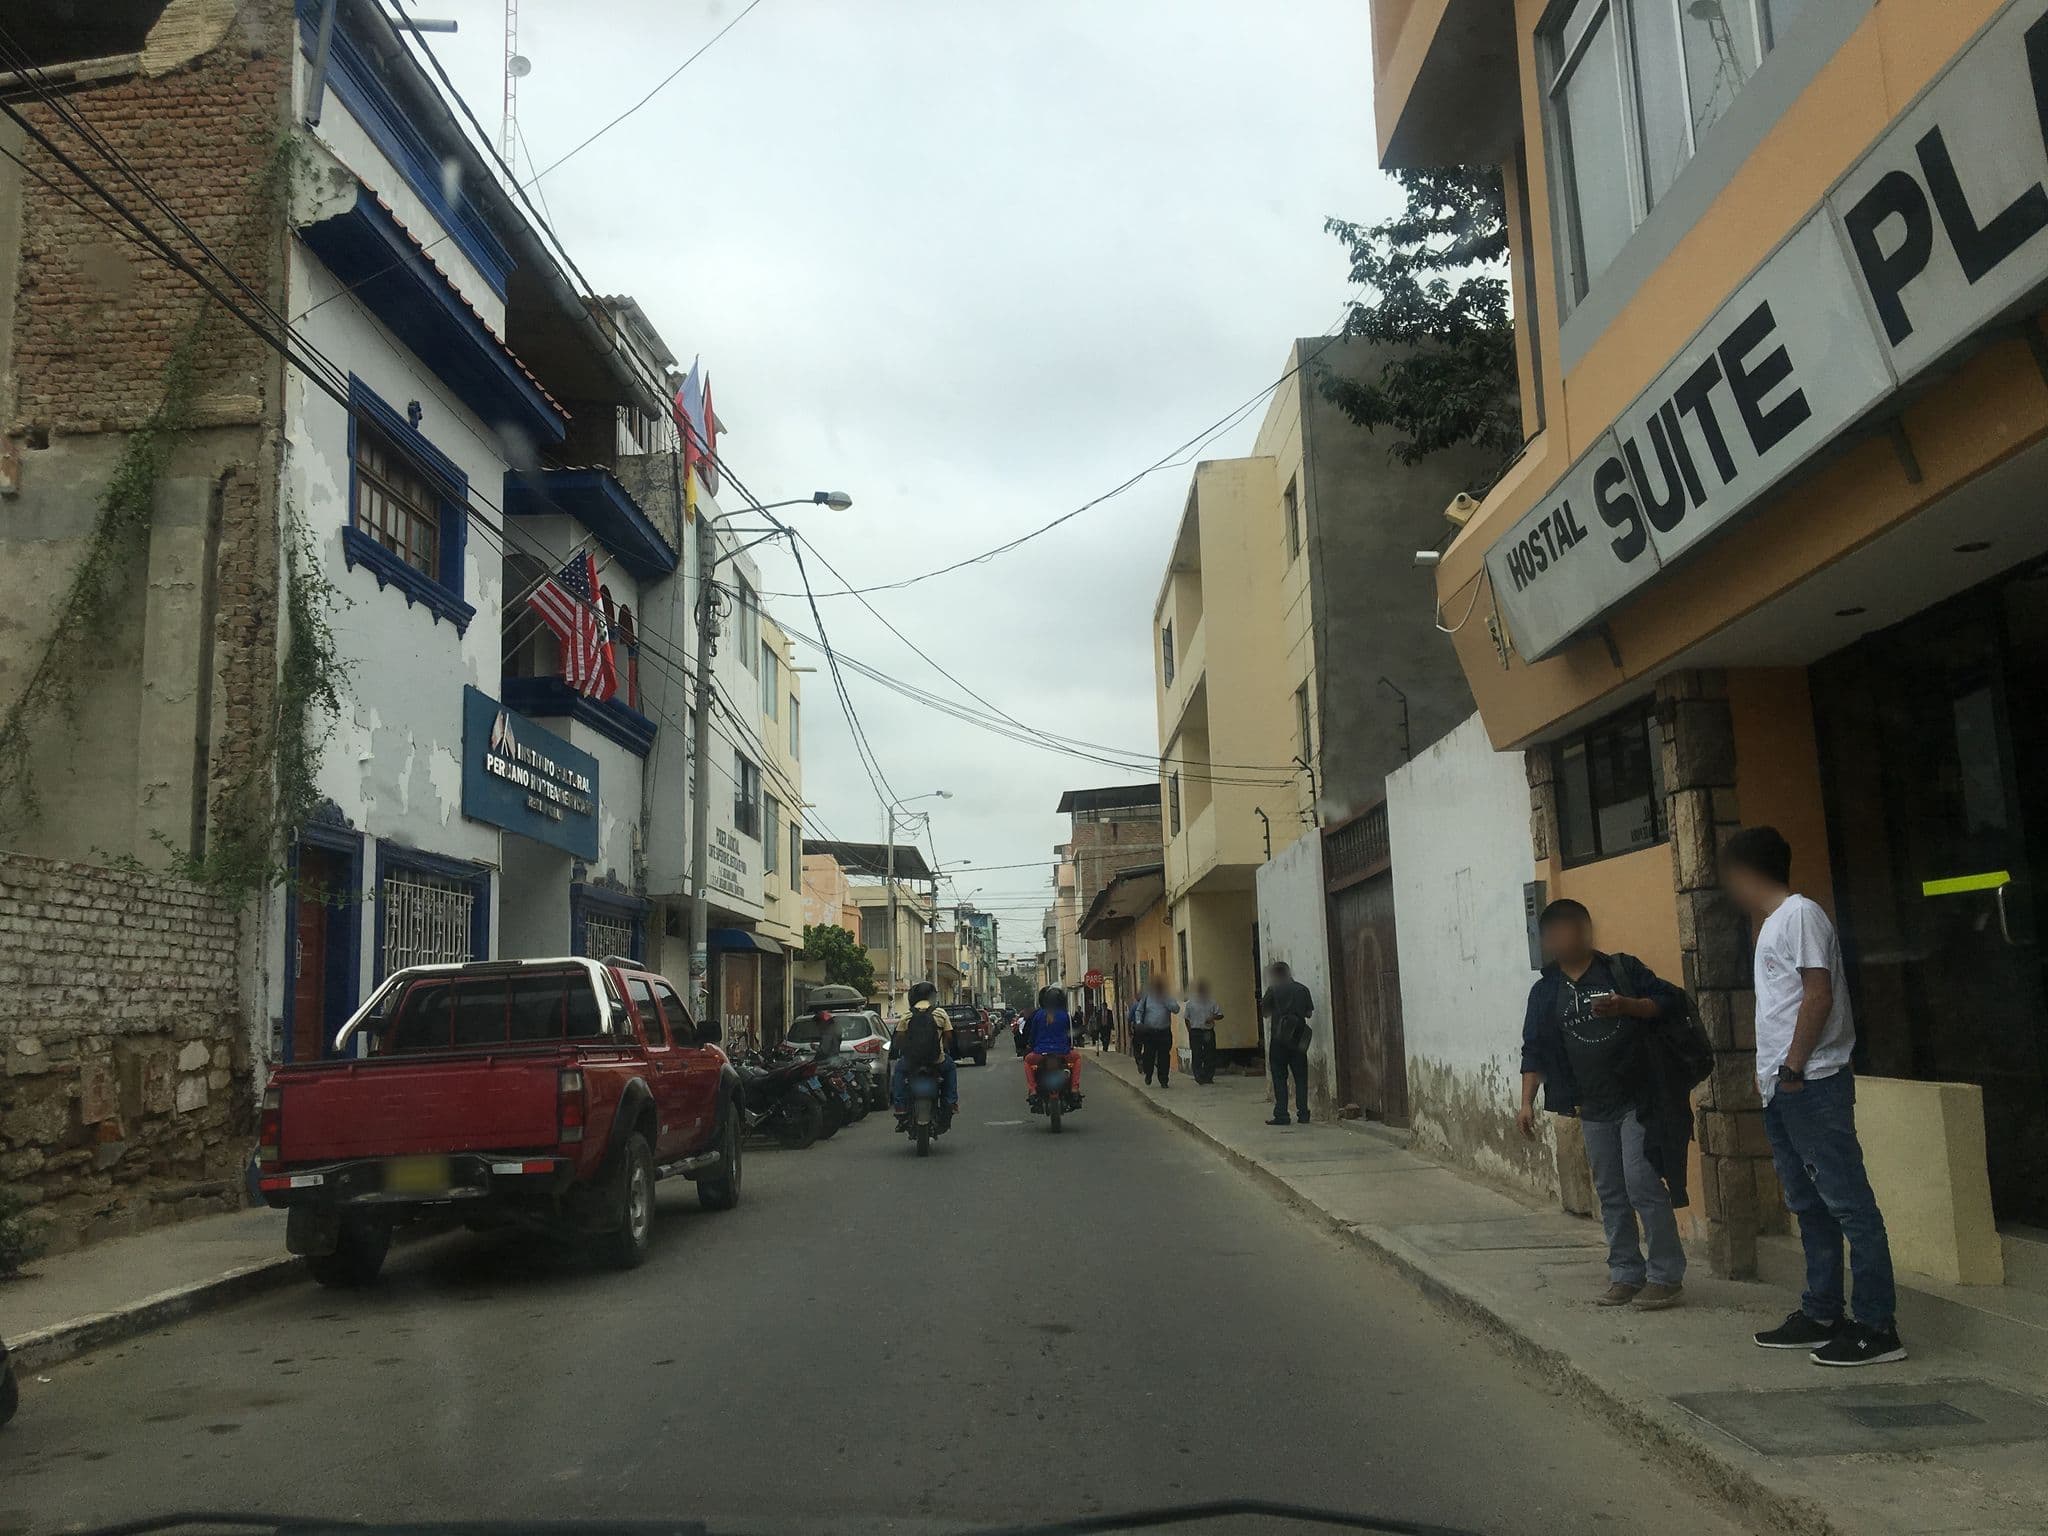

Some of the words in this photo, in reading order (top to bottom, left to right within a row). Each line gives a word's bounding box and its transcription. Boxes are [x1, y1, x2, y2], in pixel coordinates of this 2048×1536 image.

[1506, 500, 1588, 592] HOSTAL
[1592, 299, 1812, 563] SUITE
[486, 753, 529, 787] PERUANO
[530, 773, 593, 816] NORTEAMERICANO
[517, 742, 555, 776] INSTITUTO
[556, 765, 591, 794] CULTURAL
[1086, 975, 1103, 985] PARE
